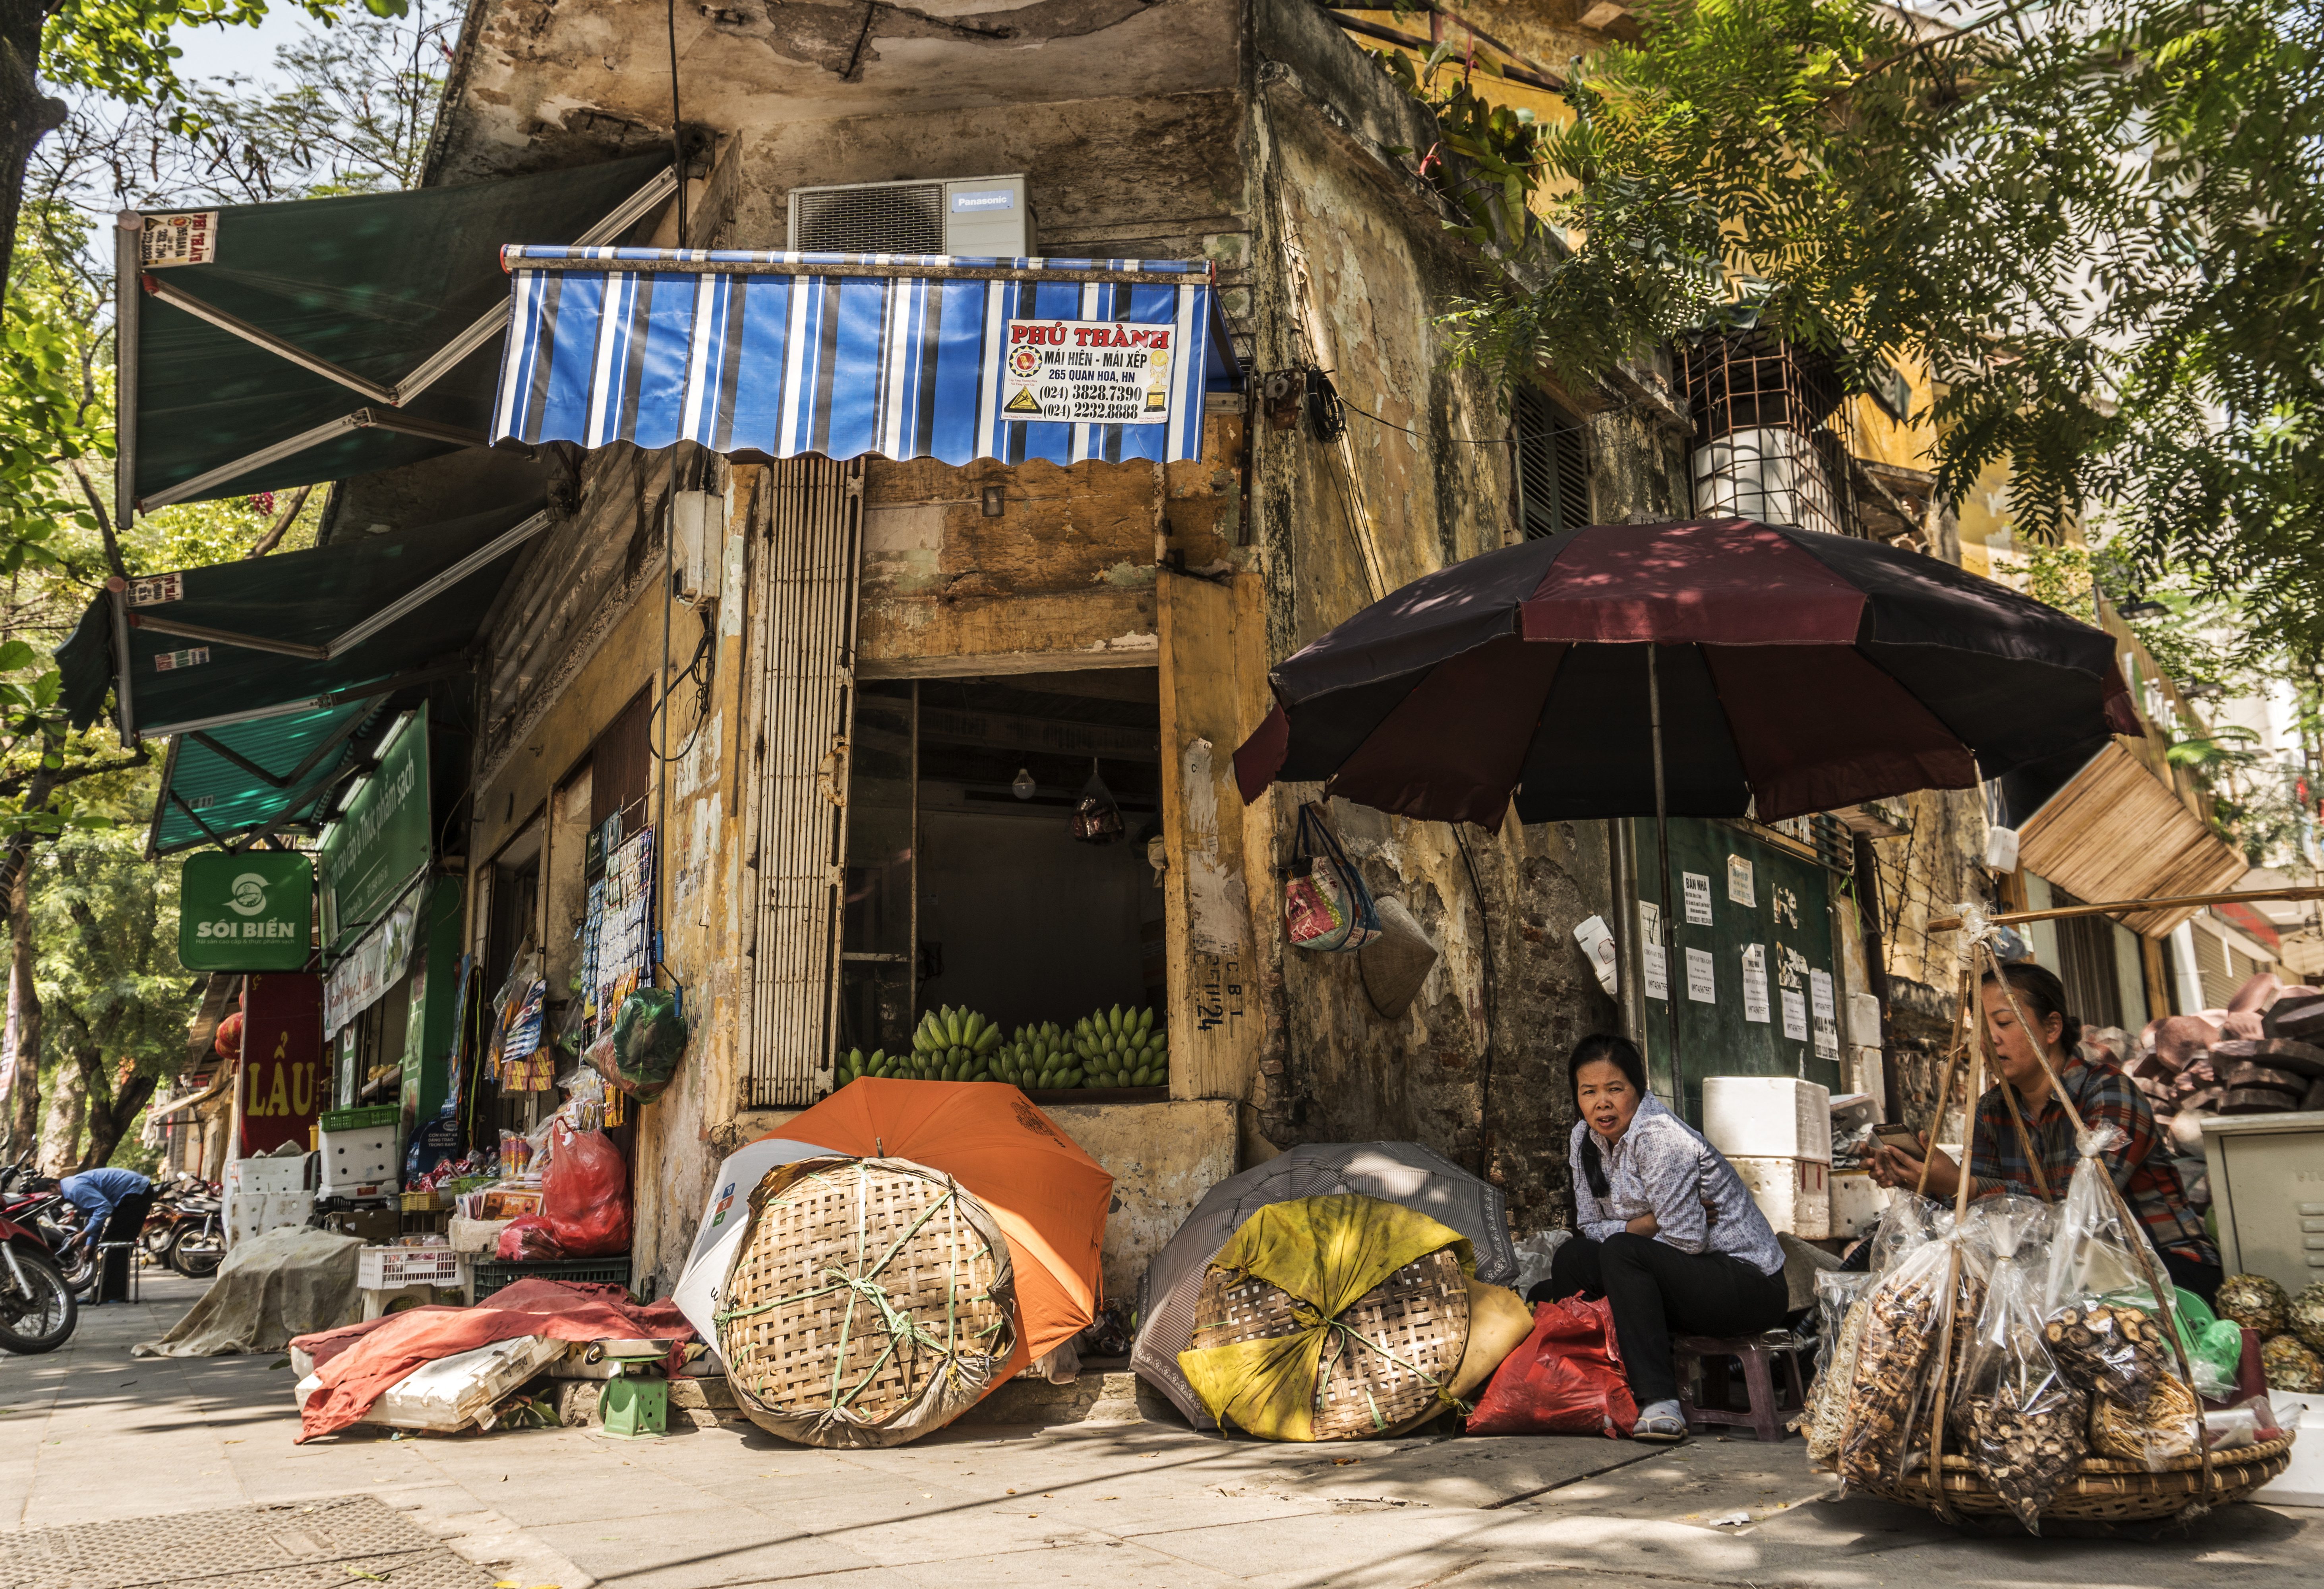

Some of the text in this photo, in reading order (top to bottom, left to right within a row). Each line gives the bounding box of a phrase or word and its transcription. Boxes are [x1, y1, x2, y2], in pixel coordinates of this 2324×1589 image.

[958, 196, 1007, 207] Panasonic
[1011, 321, 1170, 349] PHÚ THÀNH
[1044, 350, 1065, 365] MÁI
[1068, 349, 1093, 366] HIÊN
[1103, 351, 1123, 367] MÁI
[1126, 349, 1147, 369] XẾP
[1049, 369, 1135, 383] 265 QUAN HOA, HN
[1039, 385, 1068, 401] (024)
[1073, 384, 1142, 402] 3828.7390
[1044, 404, 1070, 420] (024)
[1074, 402, 1138, 419] 2232.8888
[1686, 876, 1707, 892] BÁN NHÀ
[196, 917, 295, 938] SÓI BIỂN
[1648, 979, 1668, 992] 097436755
[247, 1031, 315, 1117] LẨU
[715, 1184, 734, 1226] FPT
